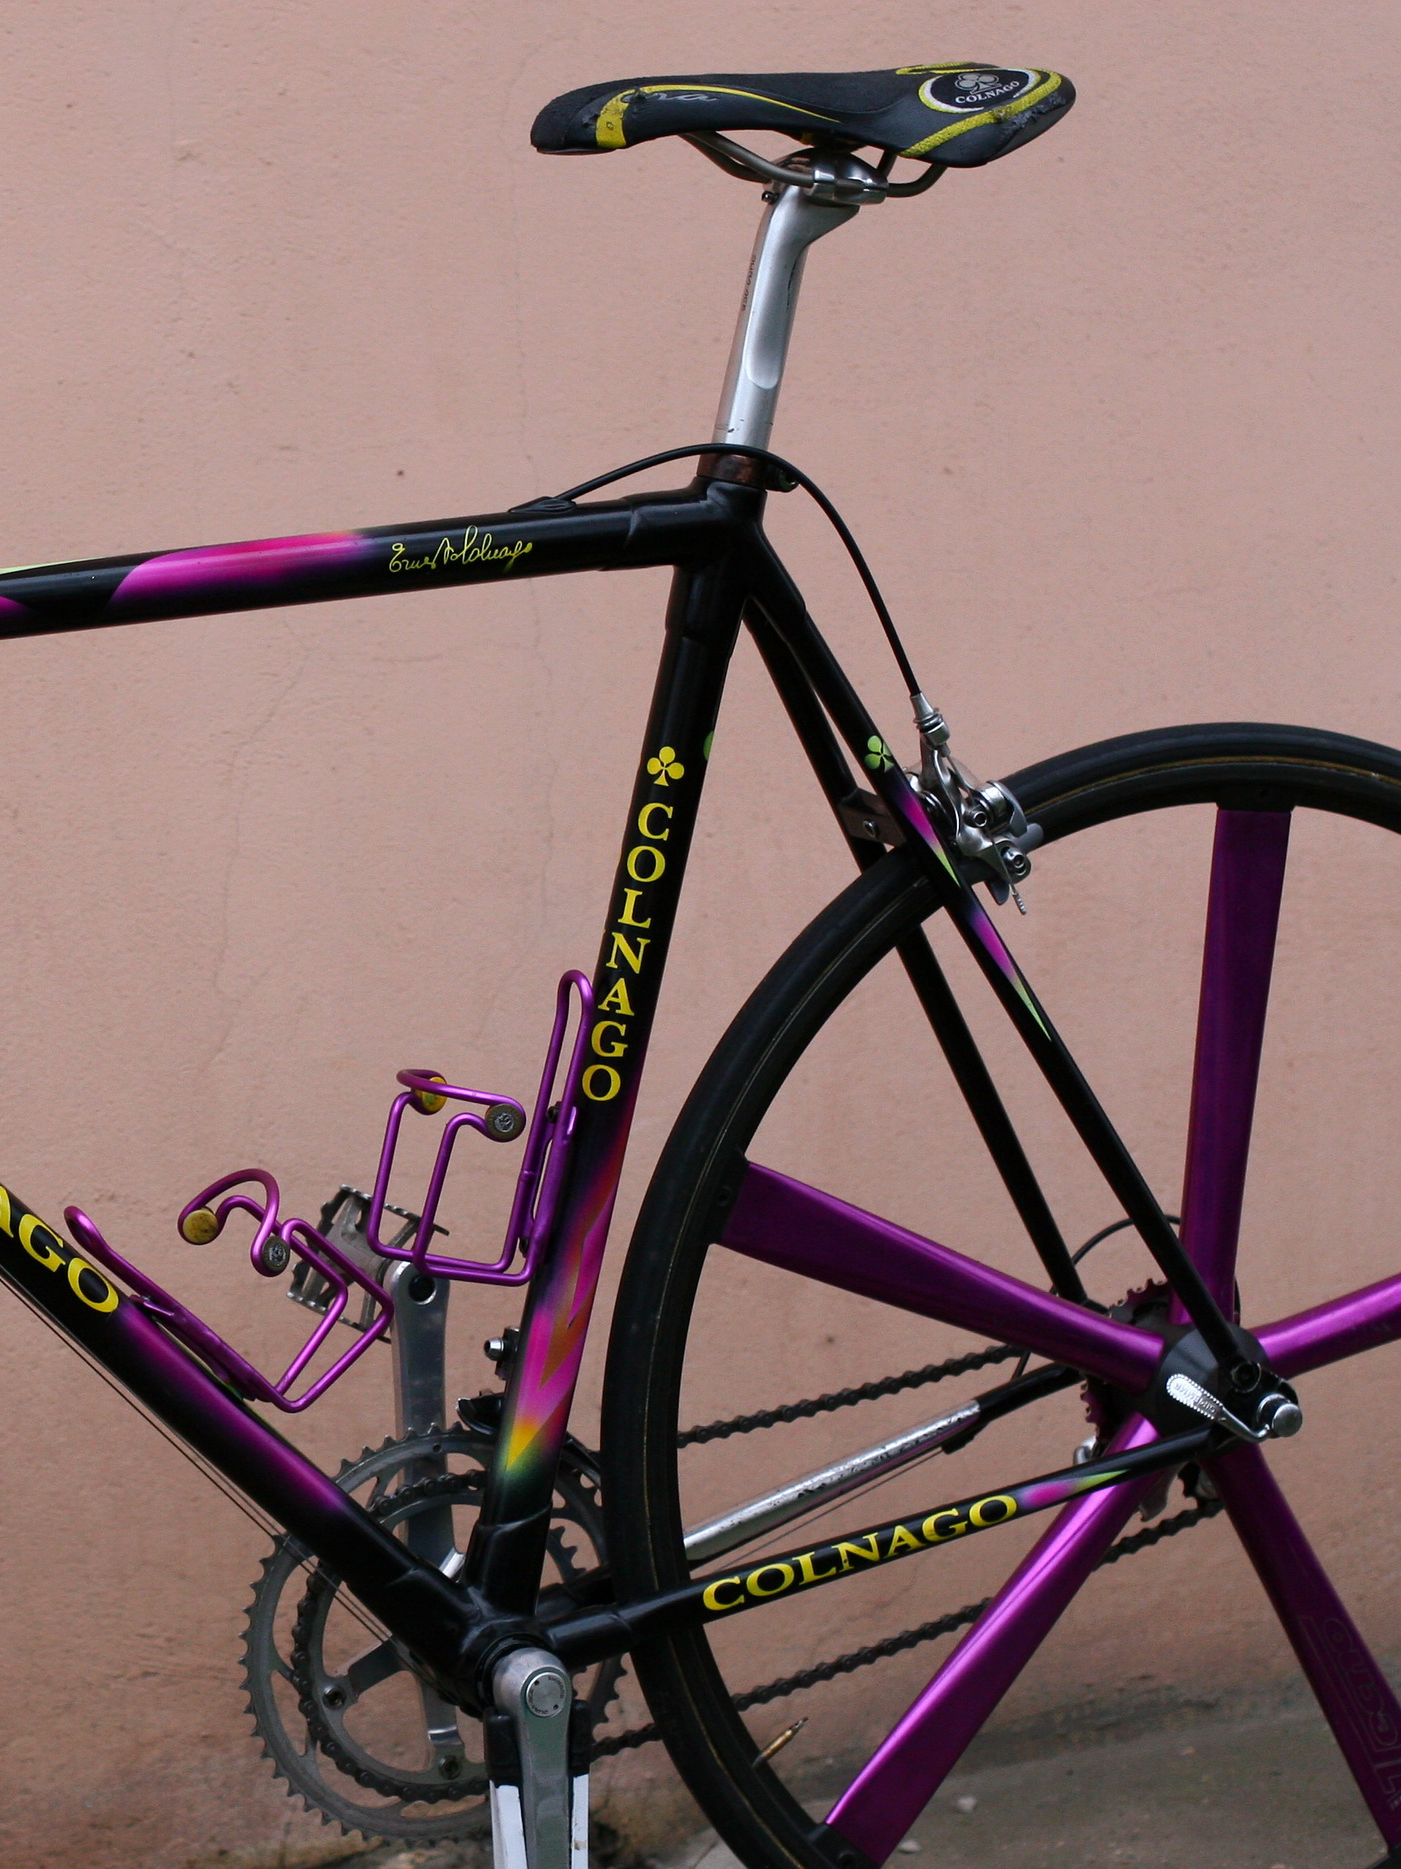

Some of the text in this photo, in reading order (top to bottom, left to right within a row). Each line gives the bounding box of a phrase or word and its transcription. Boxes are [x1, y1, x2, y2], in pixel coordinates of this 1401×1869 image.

[955, 81, 1020, 103] COLNAGO
[582, 802, 673, 1101] COLNAGO
[702, 1494, 1018, 1611] COLNAGO
